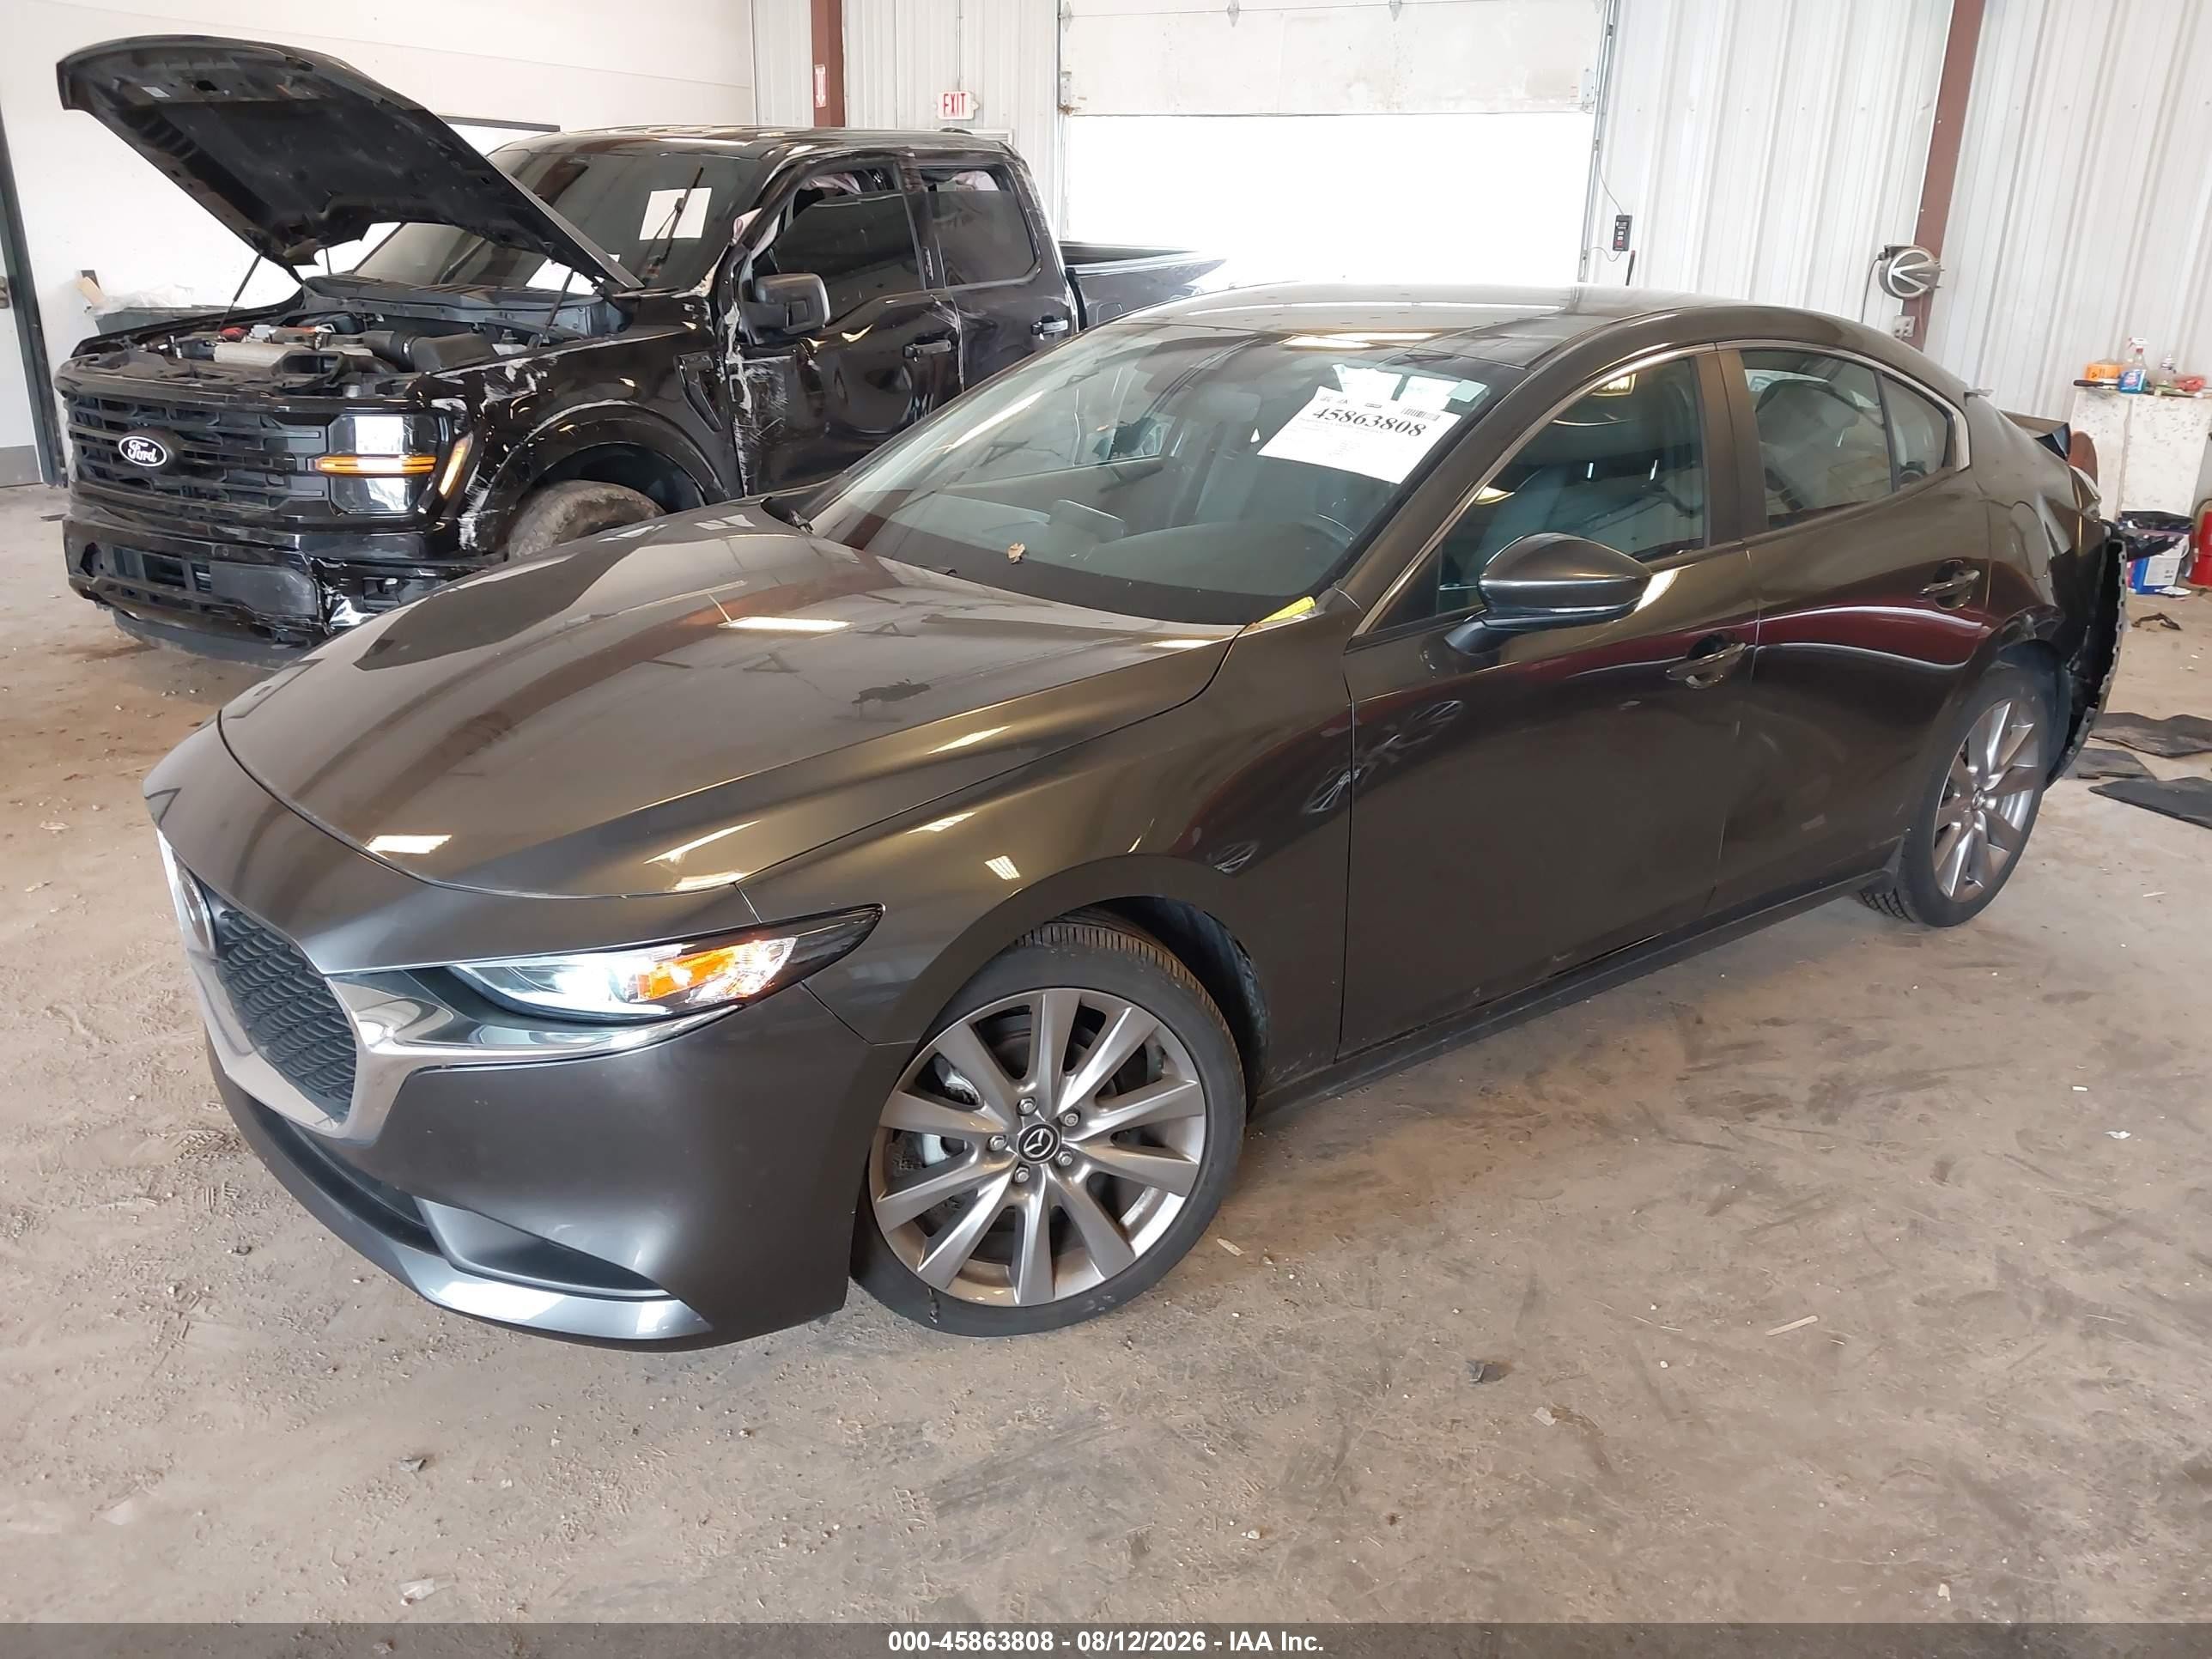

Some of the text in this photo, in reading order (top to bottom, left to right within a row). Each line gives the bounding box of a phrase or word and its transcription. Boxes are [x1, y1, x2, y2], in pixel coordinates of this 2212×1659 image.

[943, 92, 967, 117] EXIT
[1312, 408, 1427, 437] 45863808
[127, 439, 158, 463] Ford
